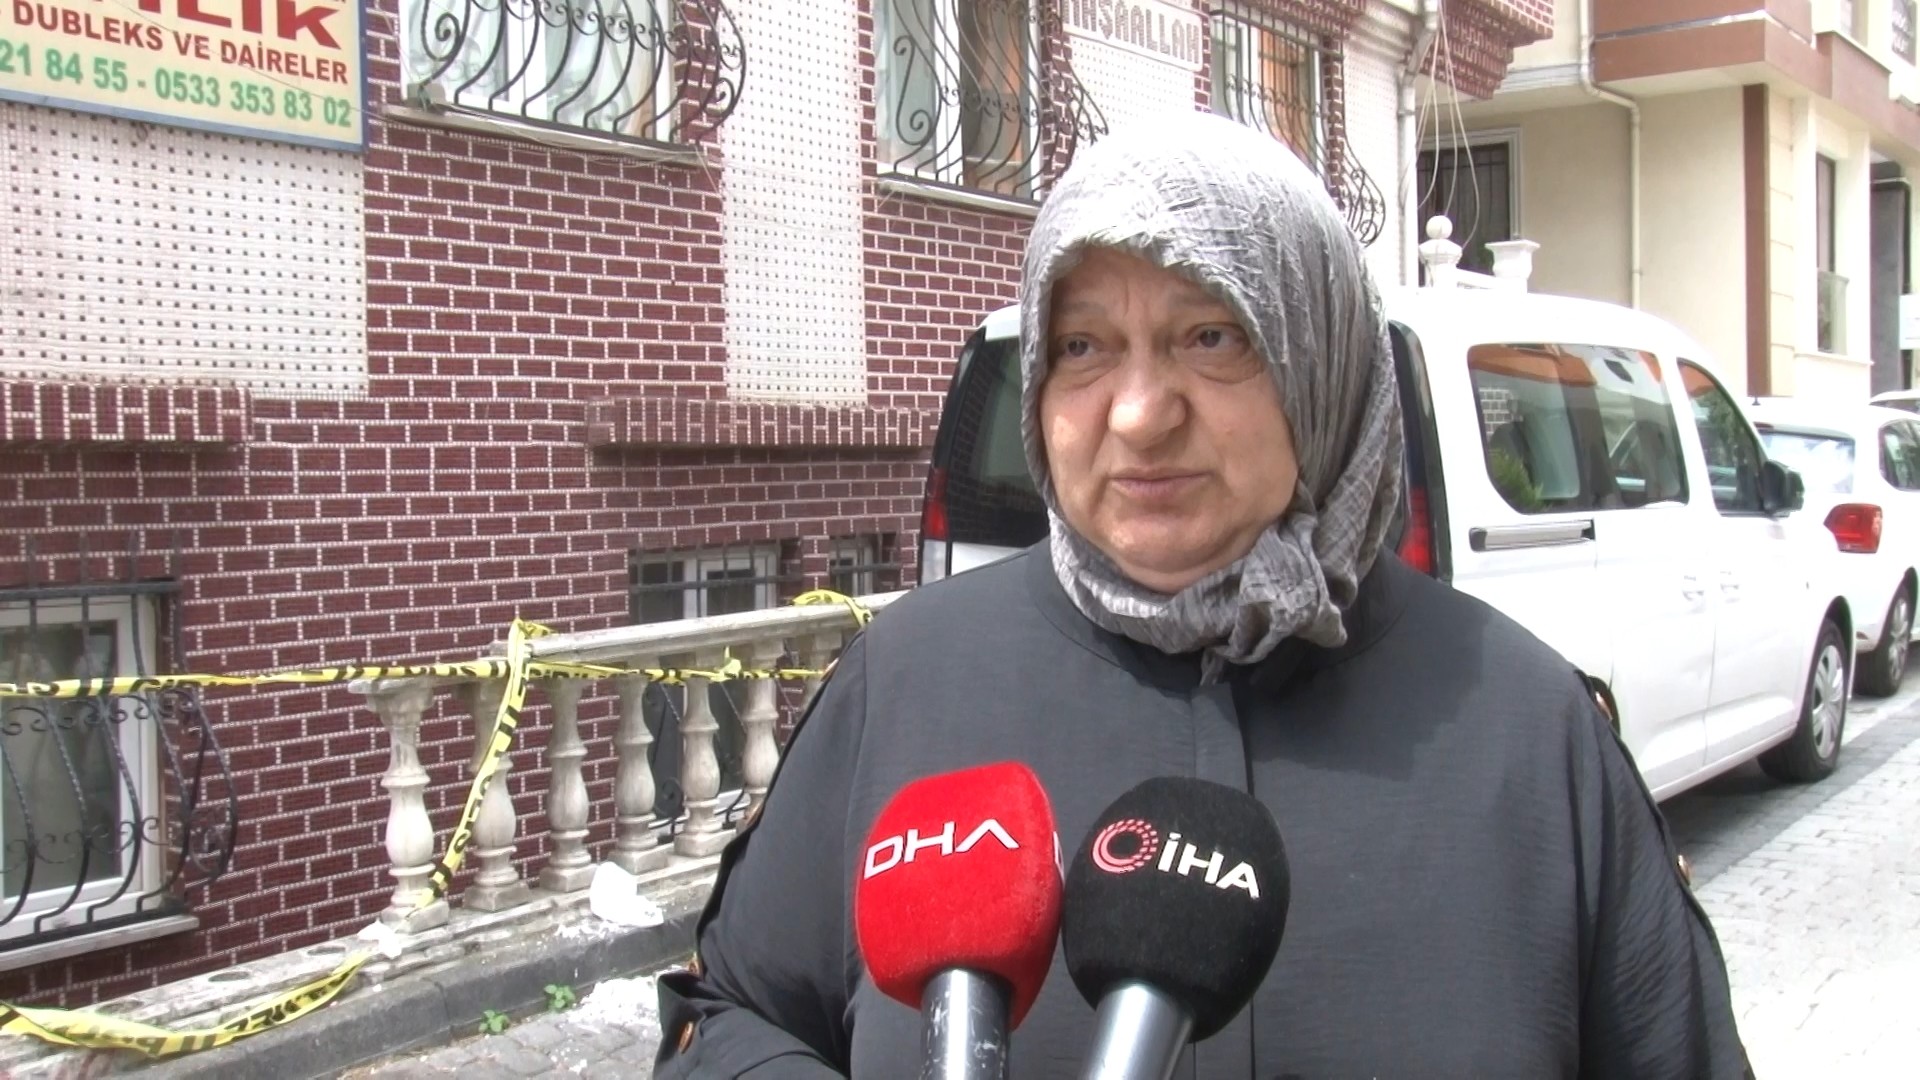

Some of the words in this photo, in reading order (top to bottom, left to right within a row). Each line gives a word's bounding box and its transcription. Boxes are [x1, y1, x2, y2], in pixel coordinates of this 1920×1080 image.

[13, 0, 163, 51] DUBLEKS
[173, 31, 210, 60] VE
[220, 40, 348, 84] DAİRELER
[46, 48, 83, 84] 84
[93, 57, 128, 92] 55
[155, 68, 220, 107] 0533
[230, 80, 275, 115] 353
[284, 90, 312, 121] 83
[323, 96, 351, 127] 02
[864, 819, 1019, 880] DHA
